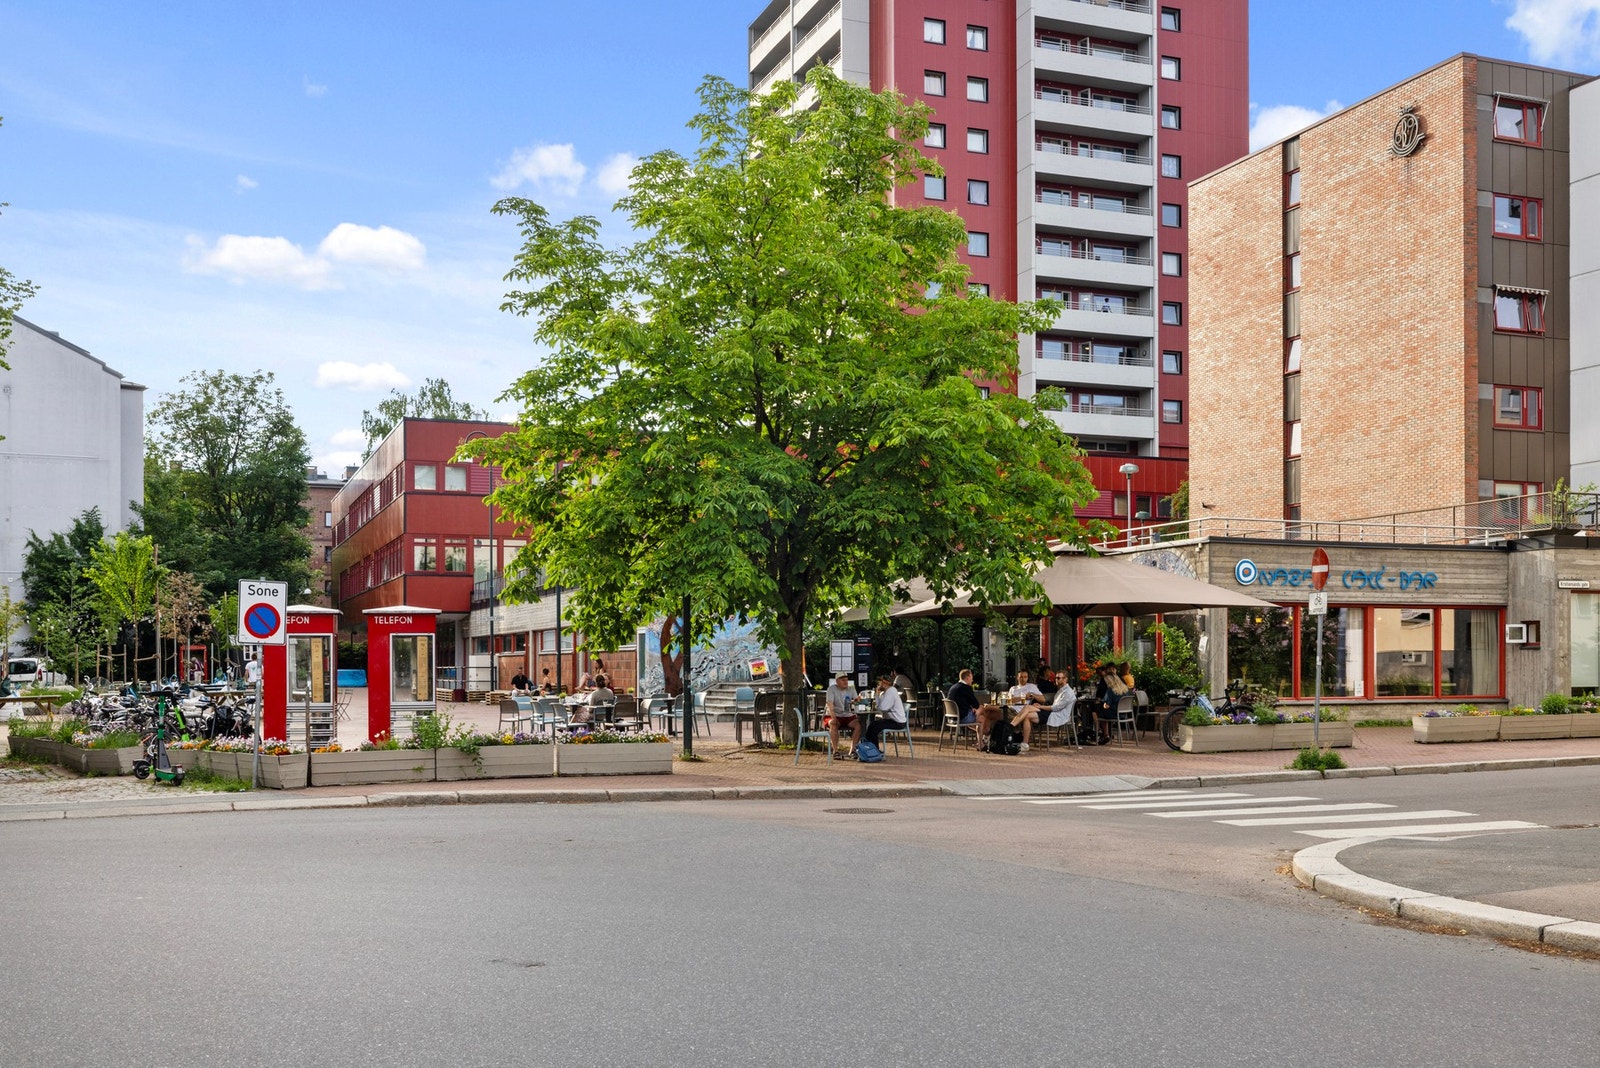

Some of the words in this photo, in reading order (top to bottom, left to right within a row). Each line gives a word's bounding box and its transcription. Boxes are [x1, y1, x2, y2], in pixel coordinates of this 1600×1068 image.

[1258, 567, 1331, 588] NAZA
[248, 584, 279, 597] Sone
[286, 616, 310, 624] EFON
[374, 616, 413, 624] TELEFON
